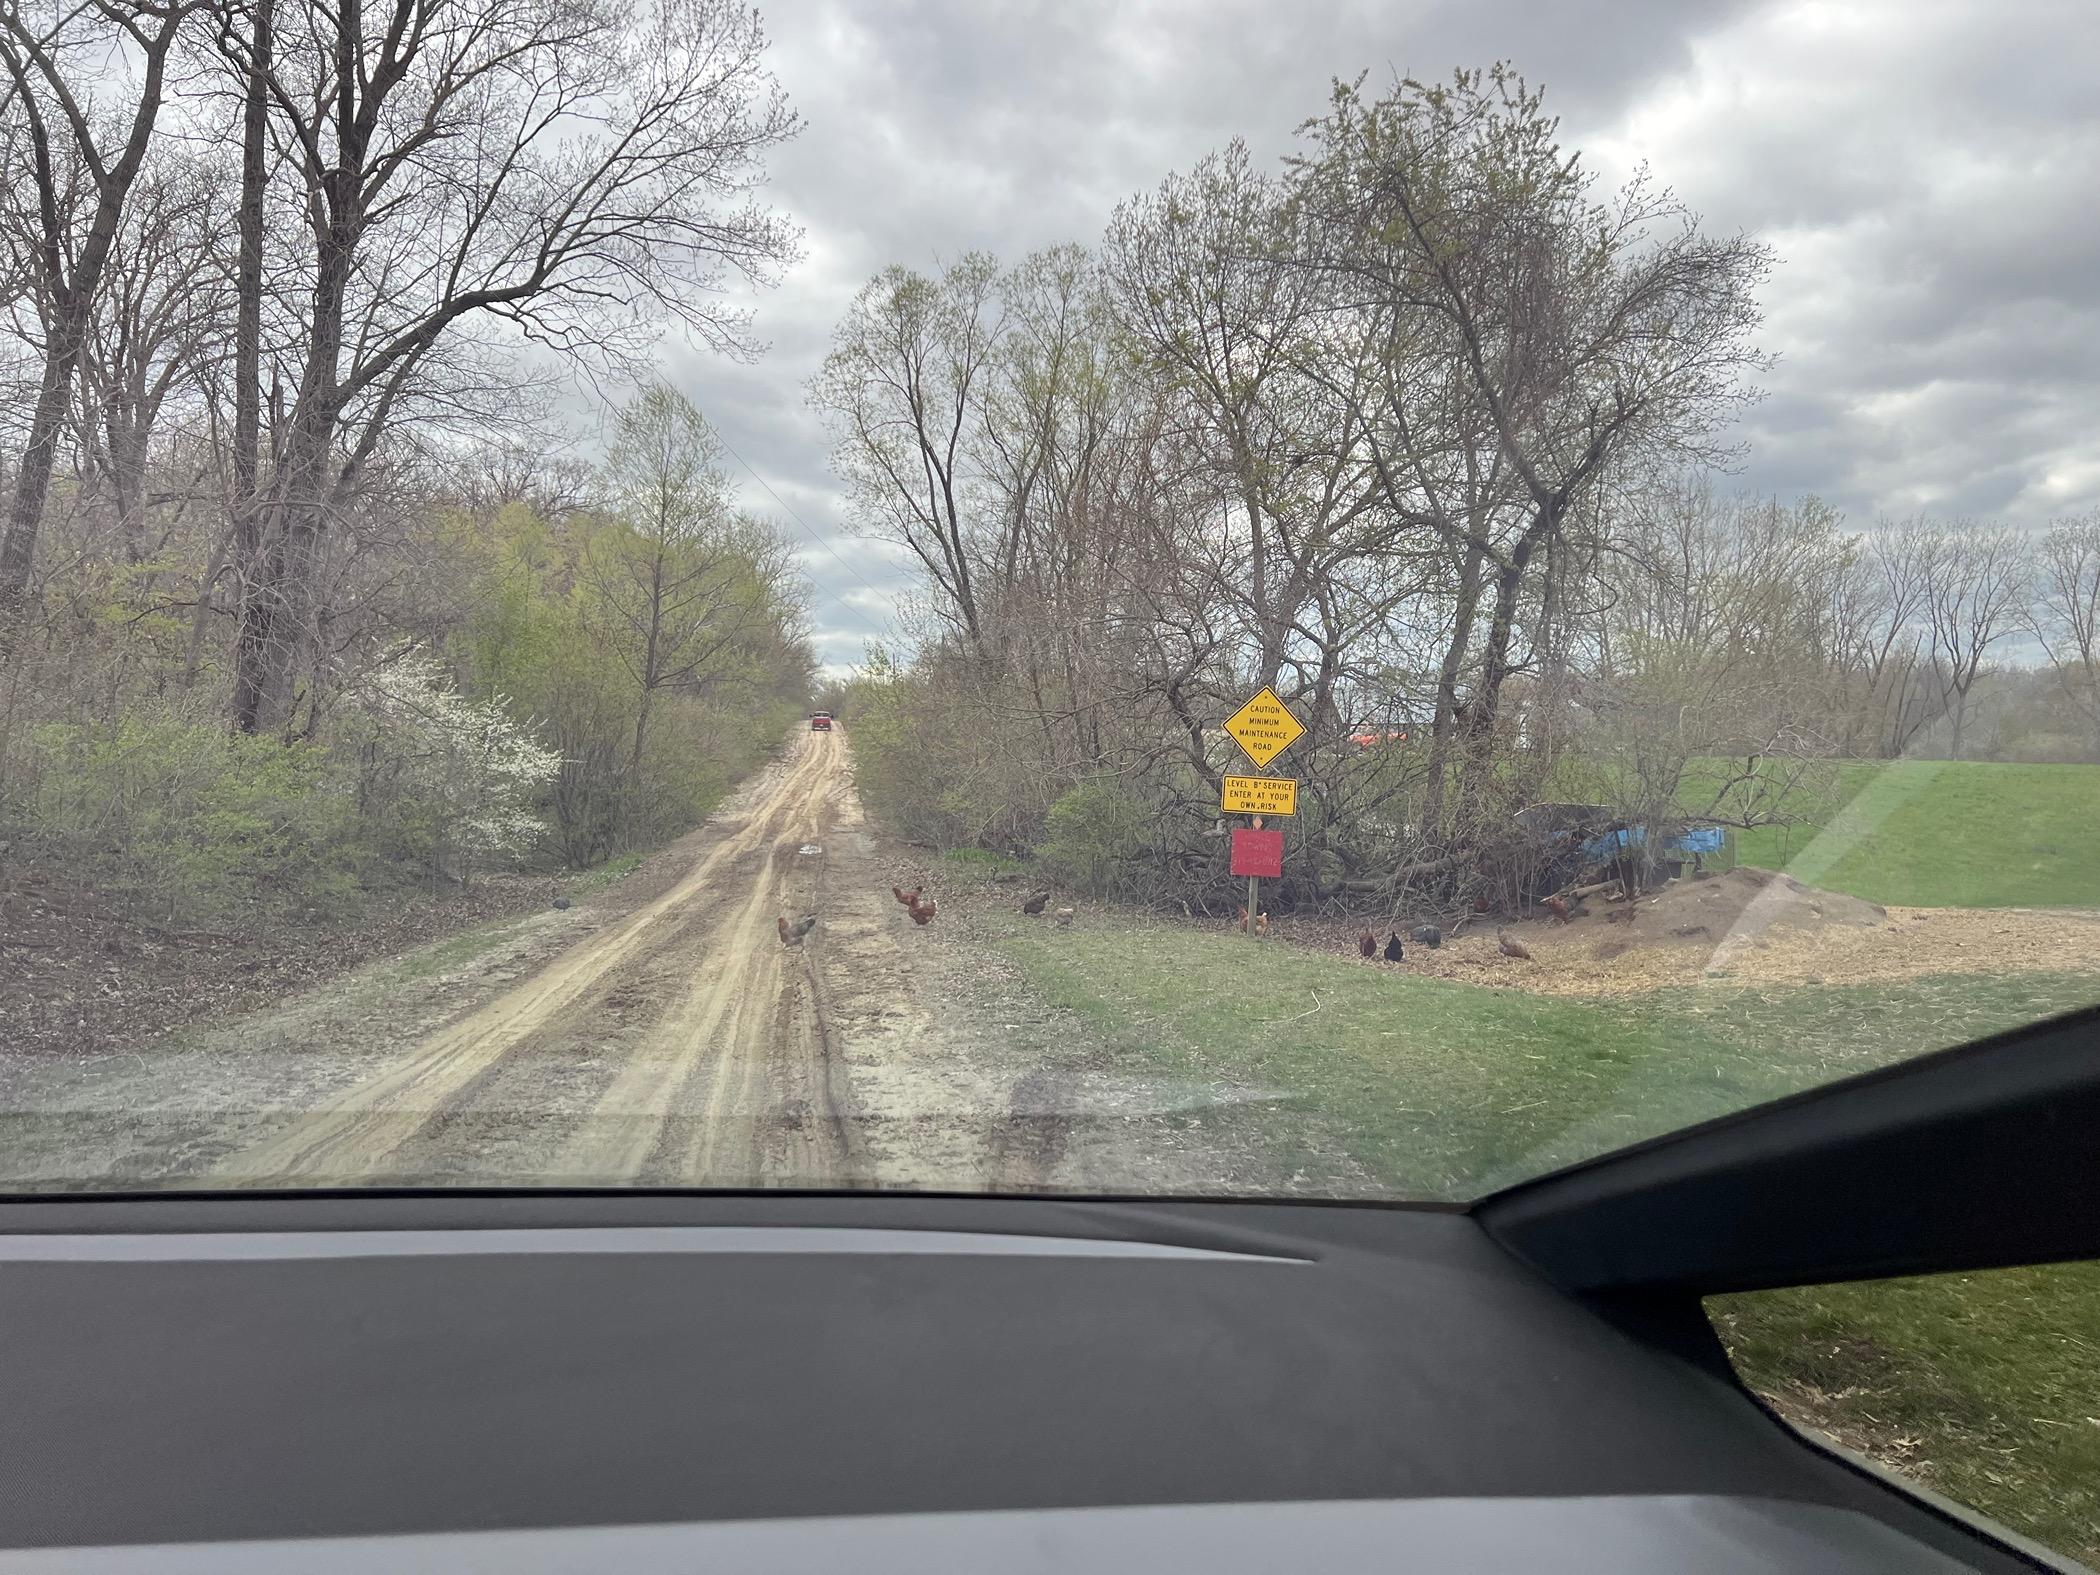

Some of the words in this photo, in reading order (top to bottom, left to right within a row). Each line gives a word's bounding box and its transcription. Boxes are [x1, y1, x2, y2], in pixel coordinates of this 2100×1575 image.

[1250, 705, 1280, 714] CAUTION
[1249, 717, 1279, 726] MINIMUM
[1239, 729, 1287, 739] MAINTENANCE
[1253, 742, 1272, 750] ROAD
[1227, 780, 1248, 788] LEVEL
[1263, 782, 1293, 790] SERVICE
[1230, 790, 1252, 798] ENTER
[1270, 793, 1289, 801] YOUR
[1261, 803, 1277, 811] RISK
